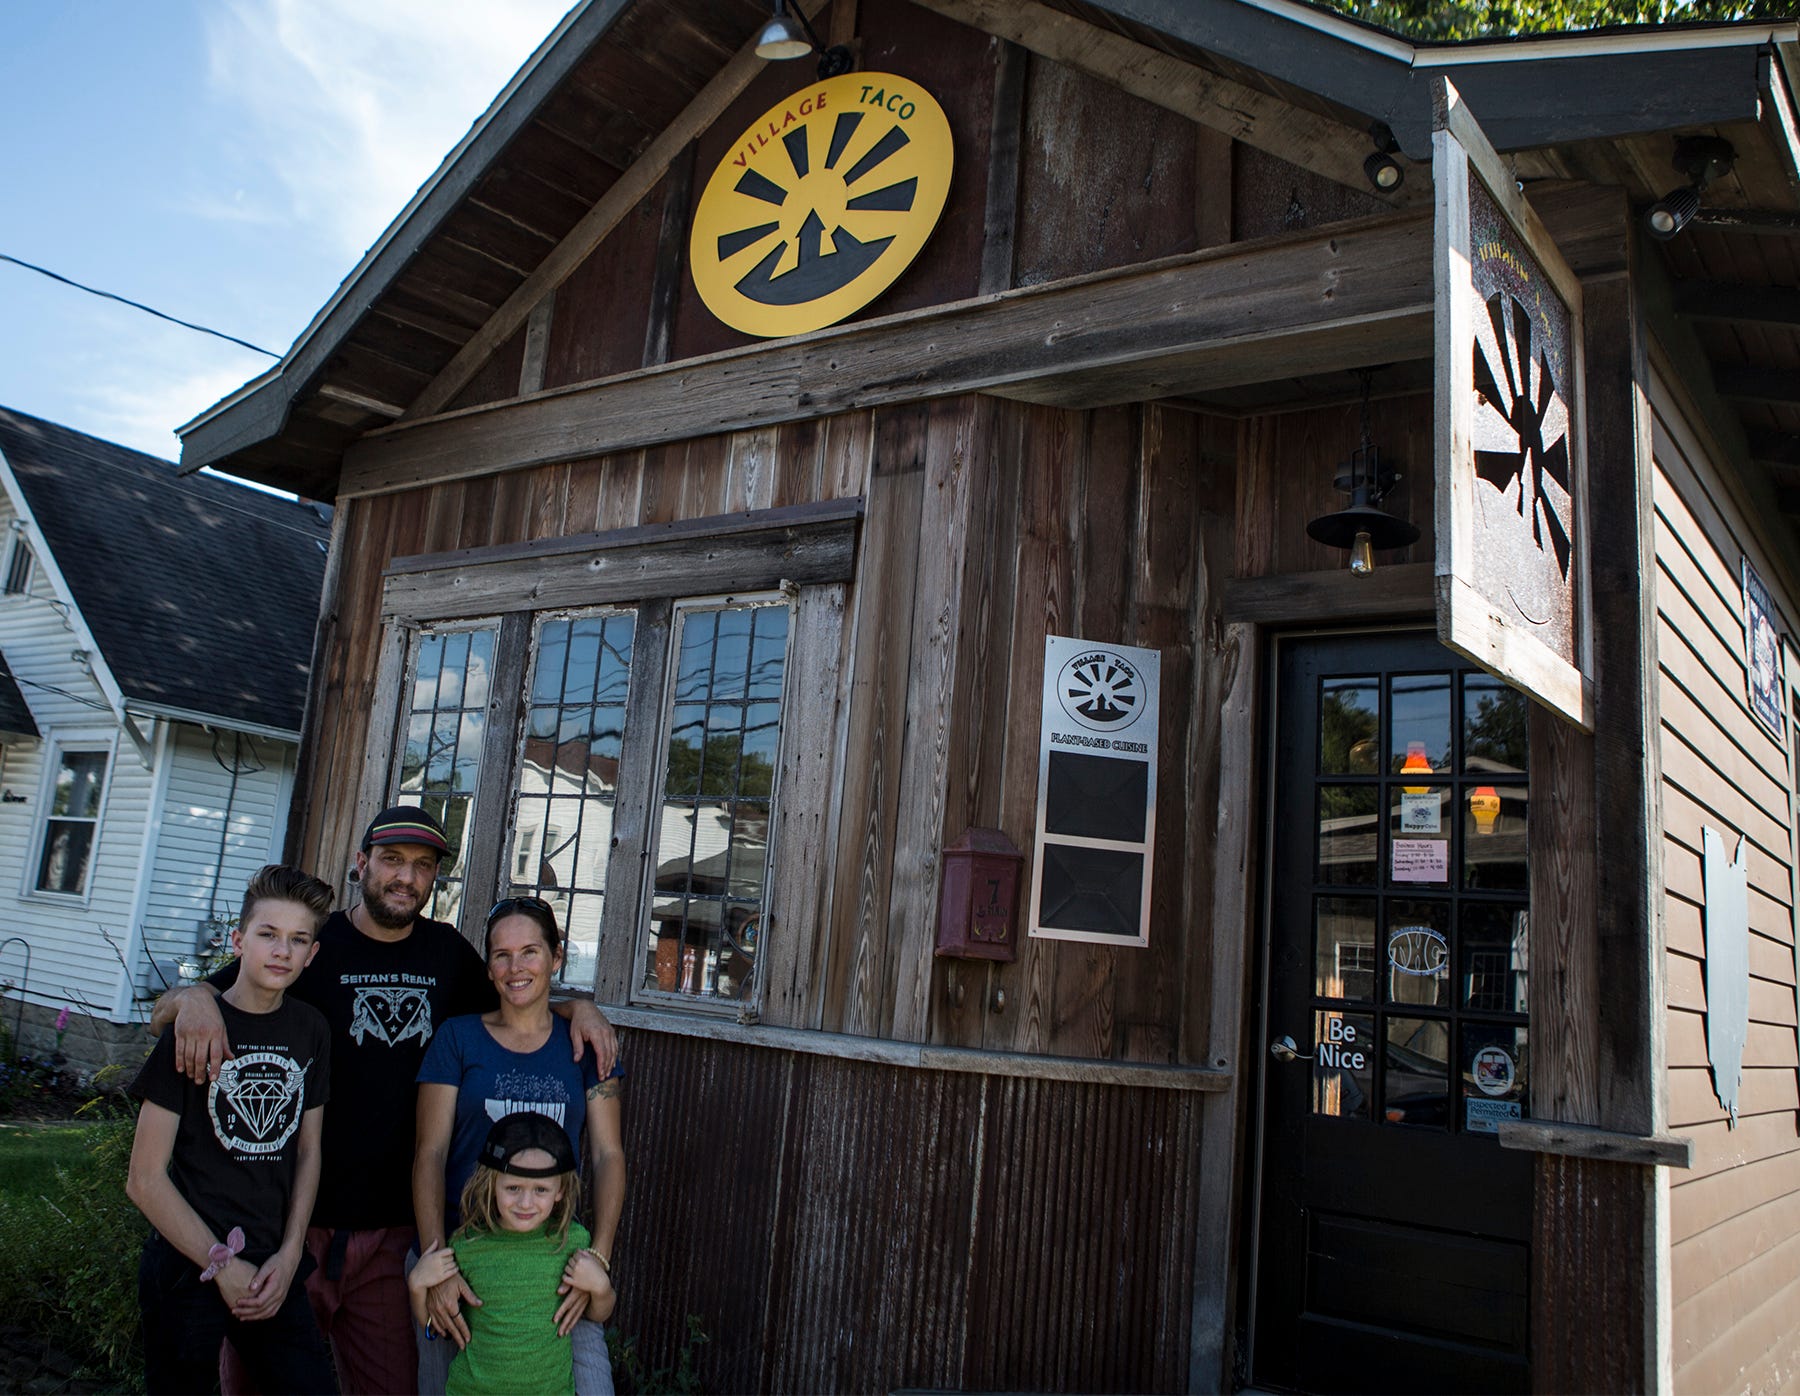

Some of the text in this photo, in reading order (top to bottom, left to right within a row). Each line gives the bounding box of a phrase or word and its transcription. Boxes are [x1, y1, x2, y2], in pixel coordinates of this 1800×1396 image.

[732, 86, 916, 168] VILLAGE TACO
[1071, 655, 1135, 679] VILLAGE TACO
[1051, 733, 1148, 754] PLANT-BASED CUISINE
[340, 973, 437, 986] SEITAN'S REALM
[1329, 1018, 1357, 1042] Be
[238, 1053, 288, 1067] AUTHENTIC
[1319, 1043, 1365, 1070] Nice
[1469, 1100, 1507, 1110] Inspected
[1471, 1107, 1509, 1117] Permitted
[1510, 1105, 1520, 1119] &
[235, 1139, 252, 1152] SINCE
